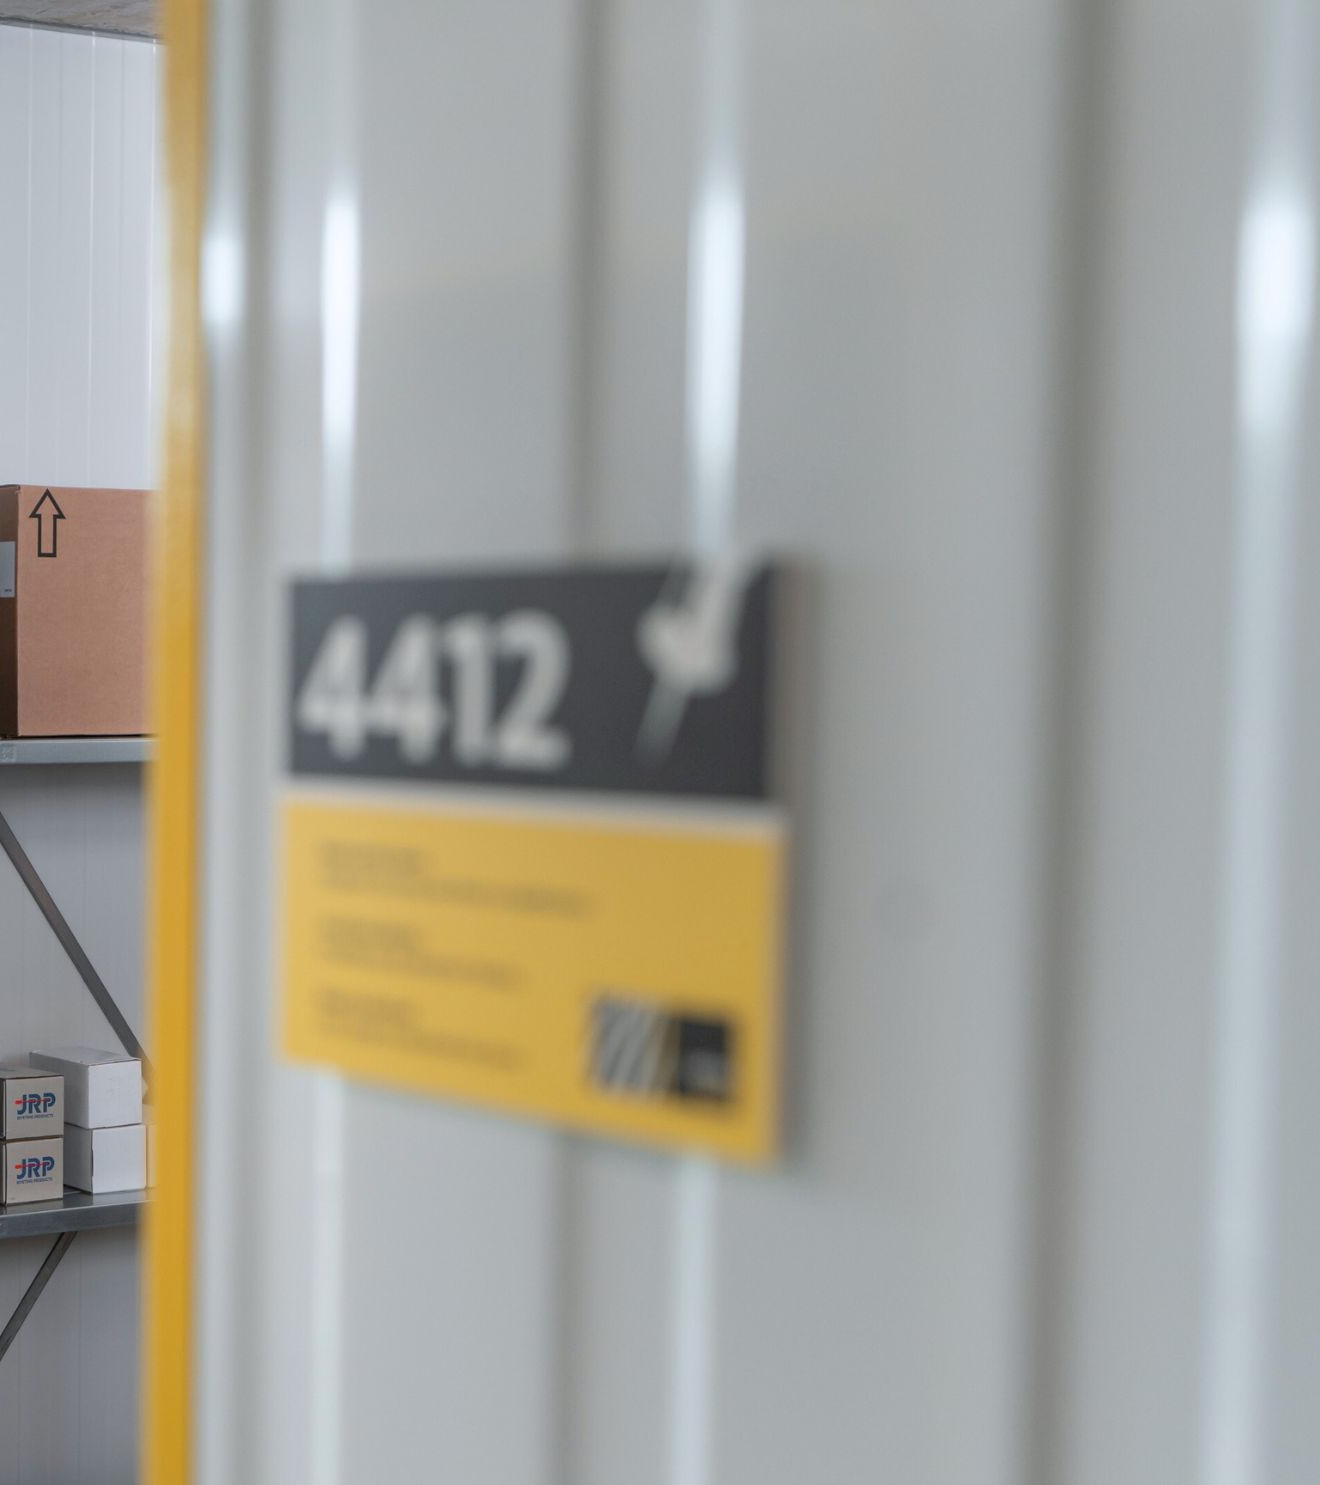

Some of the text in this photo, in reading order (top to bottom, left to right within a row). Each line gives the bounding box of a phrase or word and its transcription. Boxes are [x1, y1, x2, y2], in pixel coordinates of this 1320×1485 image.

[301, 614, 570, 769] 4412
[16, 1092, 56, 1115] JRP
[16, 1156, 55, 1180] JRP
